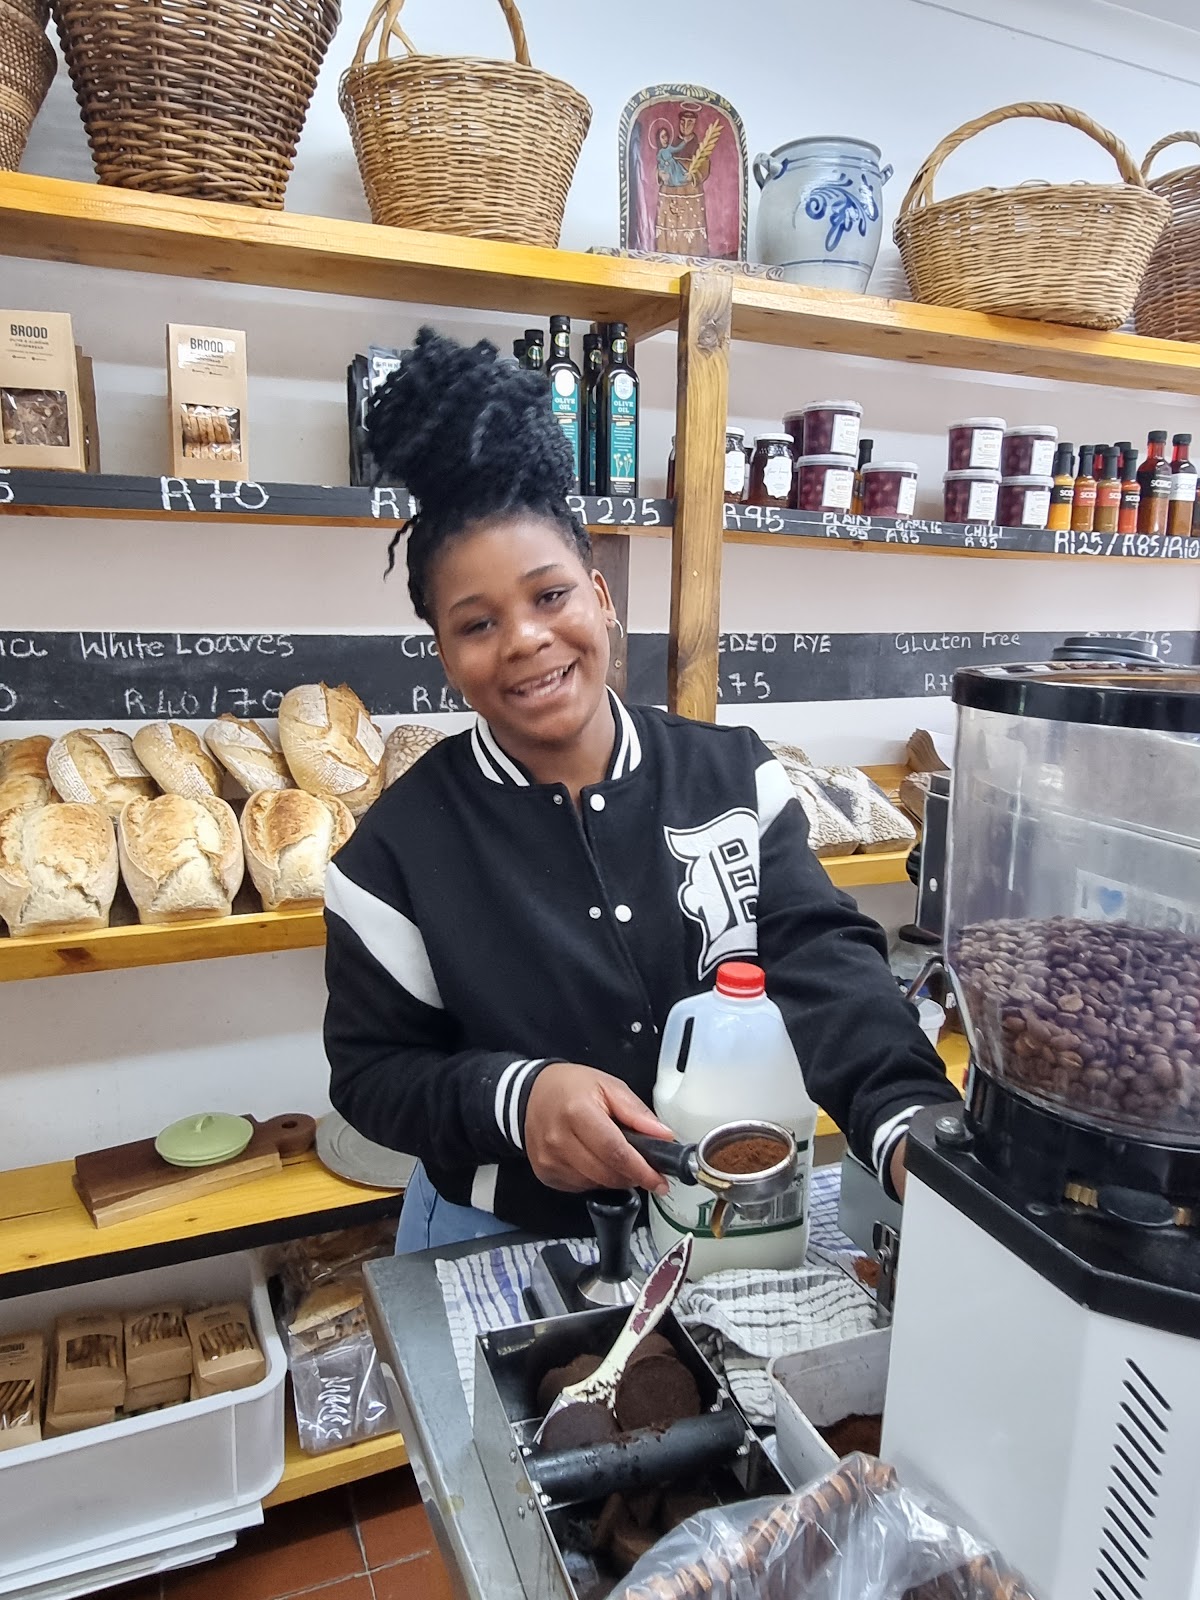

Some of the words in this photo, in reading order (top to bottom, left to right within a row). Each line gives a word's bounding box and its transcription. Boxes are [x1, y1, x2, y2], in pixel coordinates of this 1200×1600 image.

[10, 323, 48, 339] BROOD
[190, 337, 224, 353] BROOD
[554, 397, 576, 405] OLIVE
[558, 403, 572, 411] OIL
[613, 400, 634, 408] OLIVE
[723, 502, 785, 533] R95
[823, 511, 872, 528] PLAIN
[79, 631, 165, 660] White
[175, 632, 295, 658] Loaves
[793, 634, 832, 653] RYE
[716, 671, 772, 700] 75
